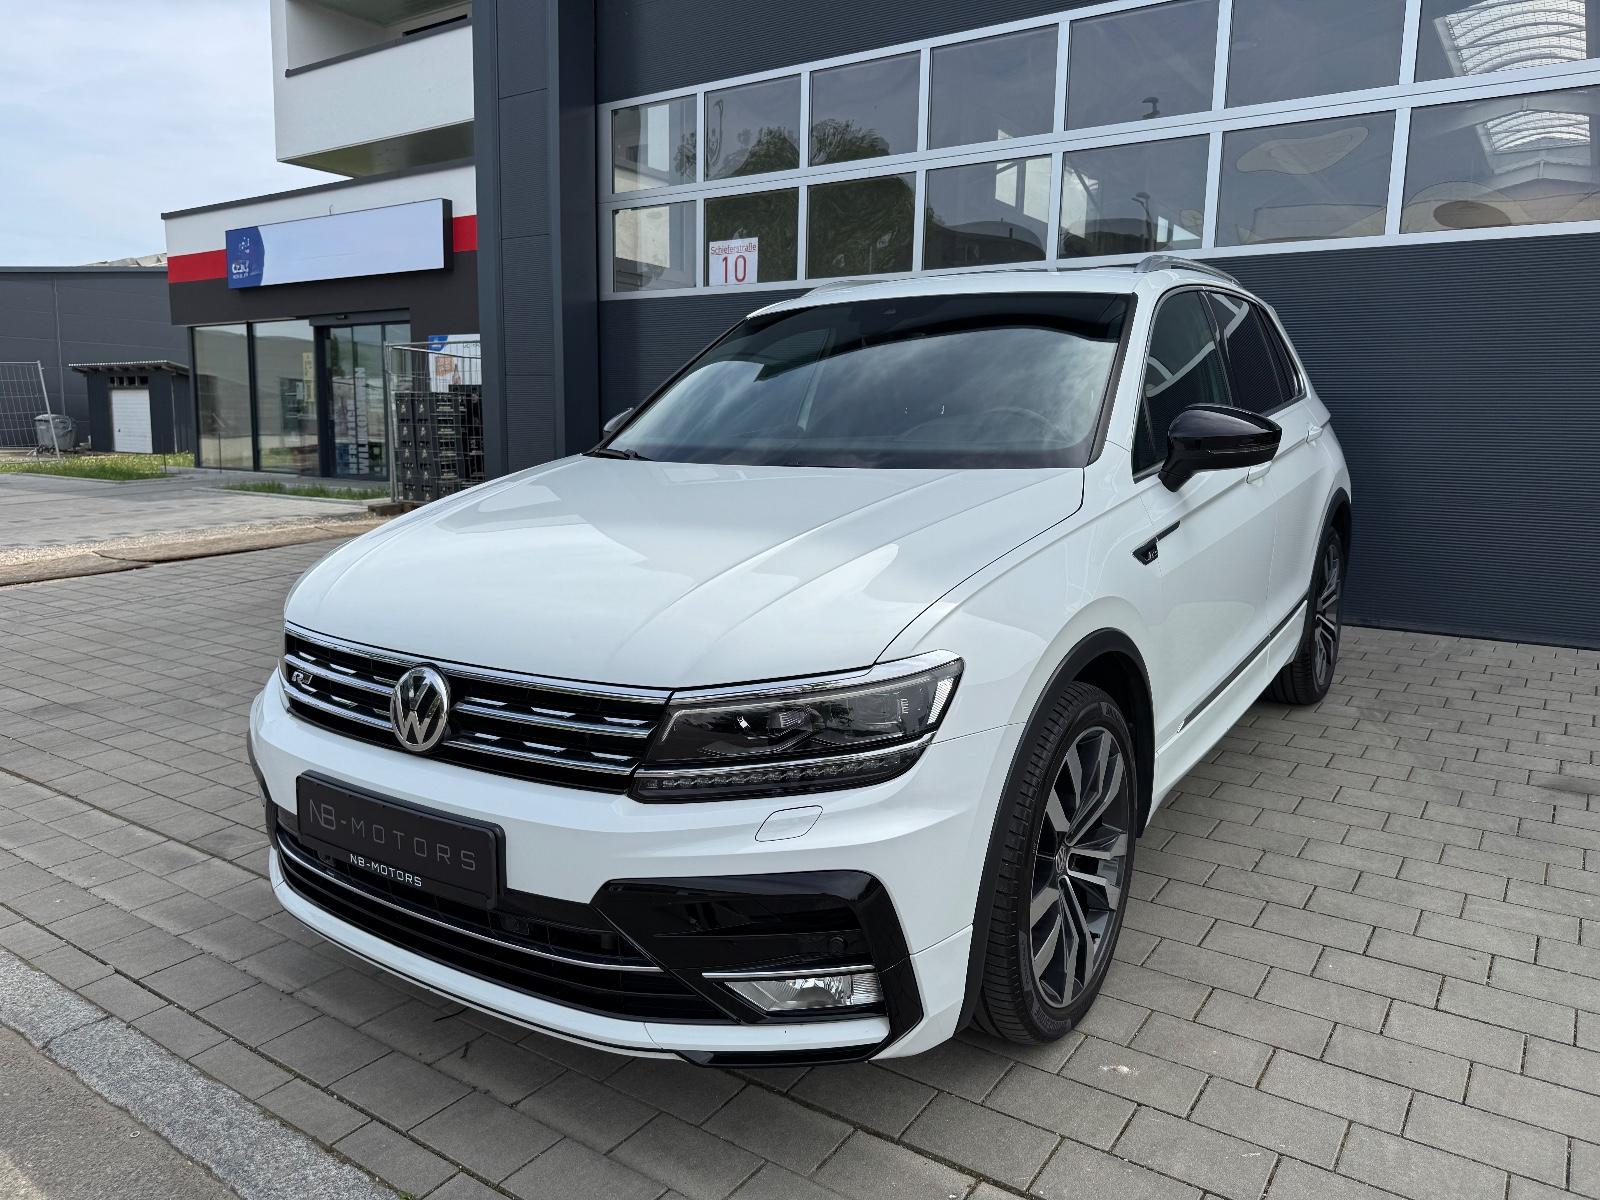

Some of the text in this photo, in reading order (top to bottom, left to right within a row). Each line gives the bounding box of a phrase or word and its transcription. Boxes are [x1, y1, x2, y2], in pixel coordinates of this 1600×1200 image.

[722, 254, 747, 284] 10
[309, 799, 476, 871] NB-MOTORS
[350, 853, 423, 887] NB-MOTORS
